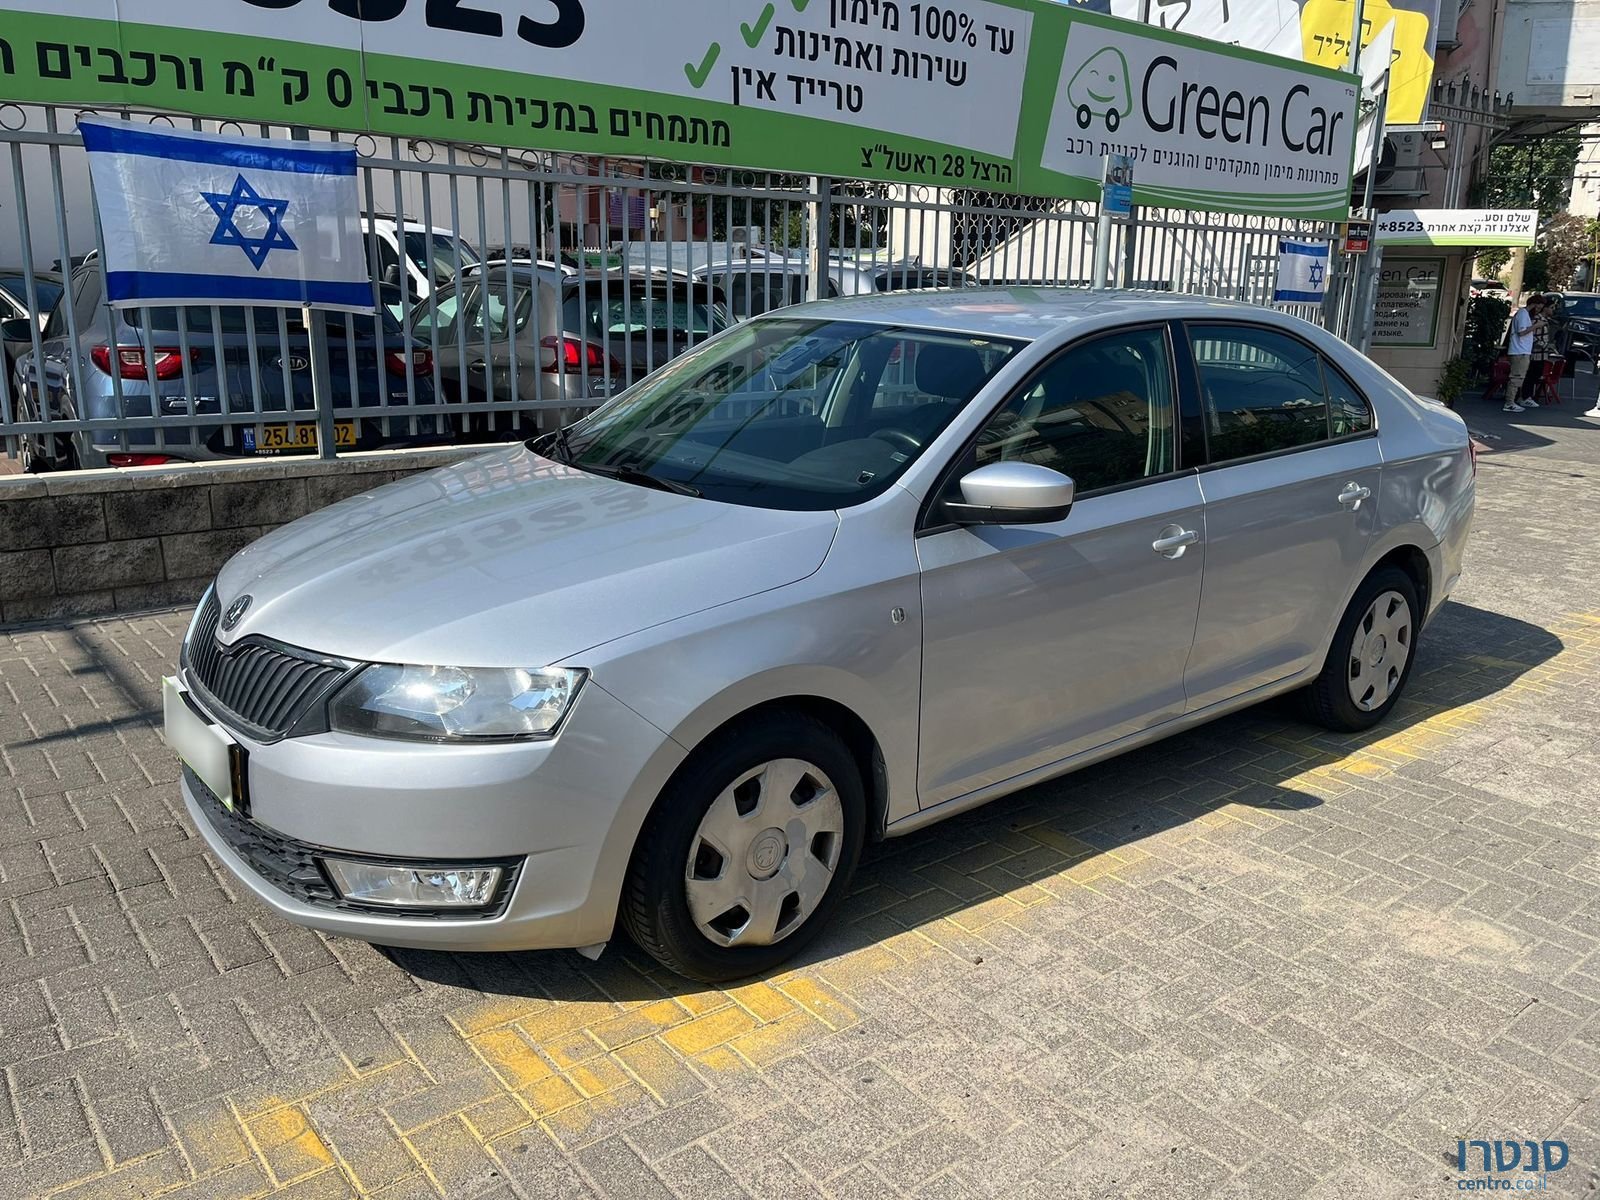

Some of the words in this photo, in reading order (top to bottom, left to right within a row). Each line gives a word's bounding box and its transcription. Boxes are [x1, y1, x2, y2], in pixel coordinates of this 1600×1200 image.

[910, 3, 977, 48] 100%
[986, 24, 1015, 55] עד
[773, 25, 883, 73] ואמינות
[35, 41, 204, 92] ורכבים
[891, 47, 968, 87] שירות
[326, 68, 353, 109] 0
[731, 64, 777, 105] אין
[787, 74, 864, 113] טרייד
[366, 79, 455, 120] רכבי
[467, 90, 599, 134] במכירת
[1141, 54, 1271, 147] Green
[1281, 84, 1344, 156] Car
[608, 107, 731, 148] מתמחים
[1066, 136, 1094, 158] רכב
[1152, 150, 1200, 172] והוגנים
[942, 153, 965, 178] 28
[970, 155, 1013, 184] הרצל
[1205, 157, 1260, 180] מתקדמים
[1264, 164, 1294, 181] מימון
[1296, 166, 1339, 186] פתרונות
[1427, 224, 1456, 232] אחרת
[1459, 223, 1482, 234] קצת
[1484, 224, 1497, 232] זה
[1499, 223, 1530, 233] אצלנו
[1507, 212, 1531, 223] שלם
[1406, 266, 1436, 282] Car
